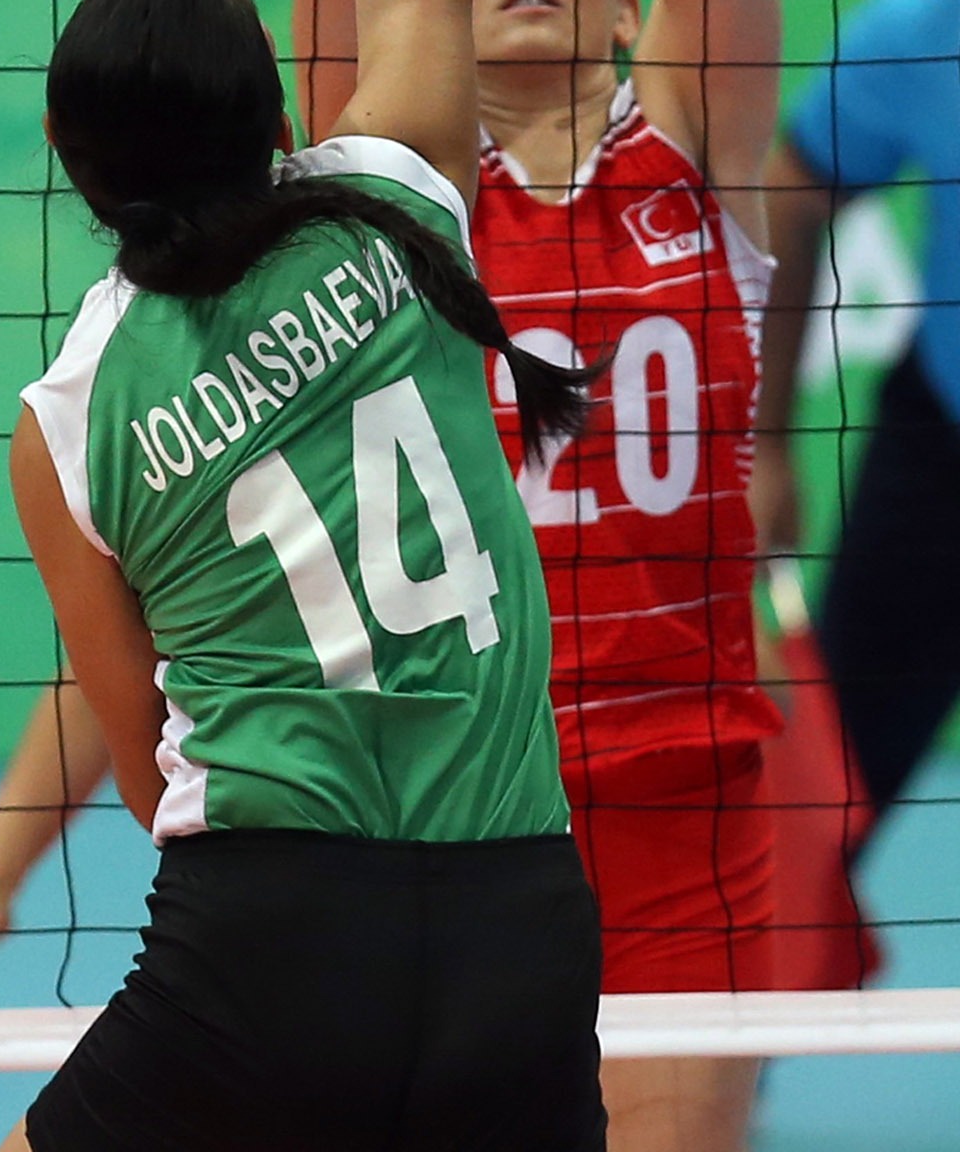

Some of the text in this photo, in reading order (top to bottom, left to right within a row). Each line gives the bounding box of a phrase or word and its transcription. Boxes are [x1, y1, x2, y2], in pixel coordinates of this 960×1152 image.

[130, 237, 417, 493] JOLDASBAEVA
[494, 315, 699, 527] 20
[226, 375, 501, 693] 14
